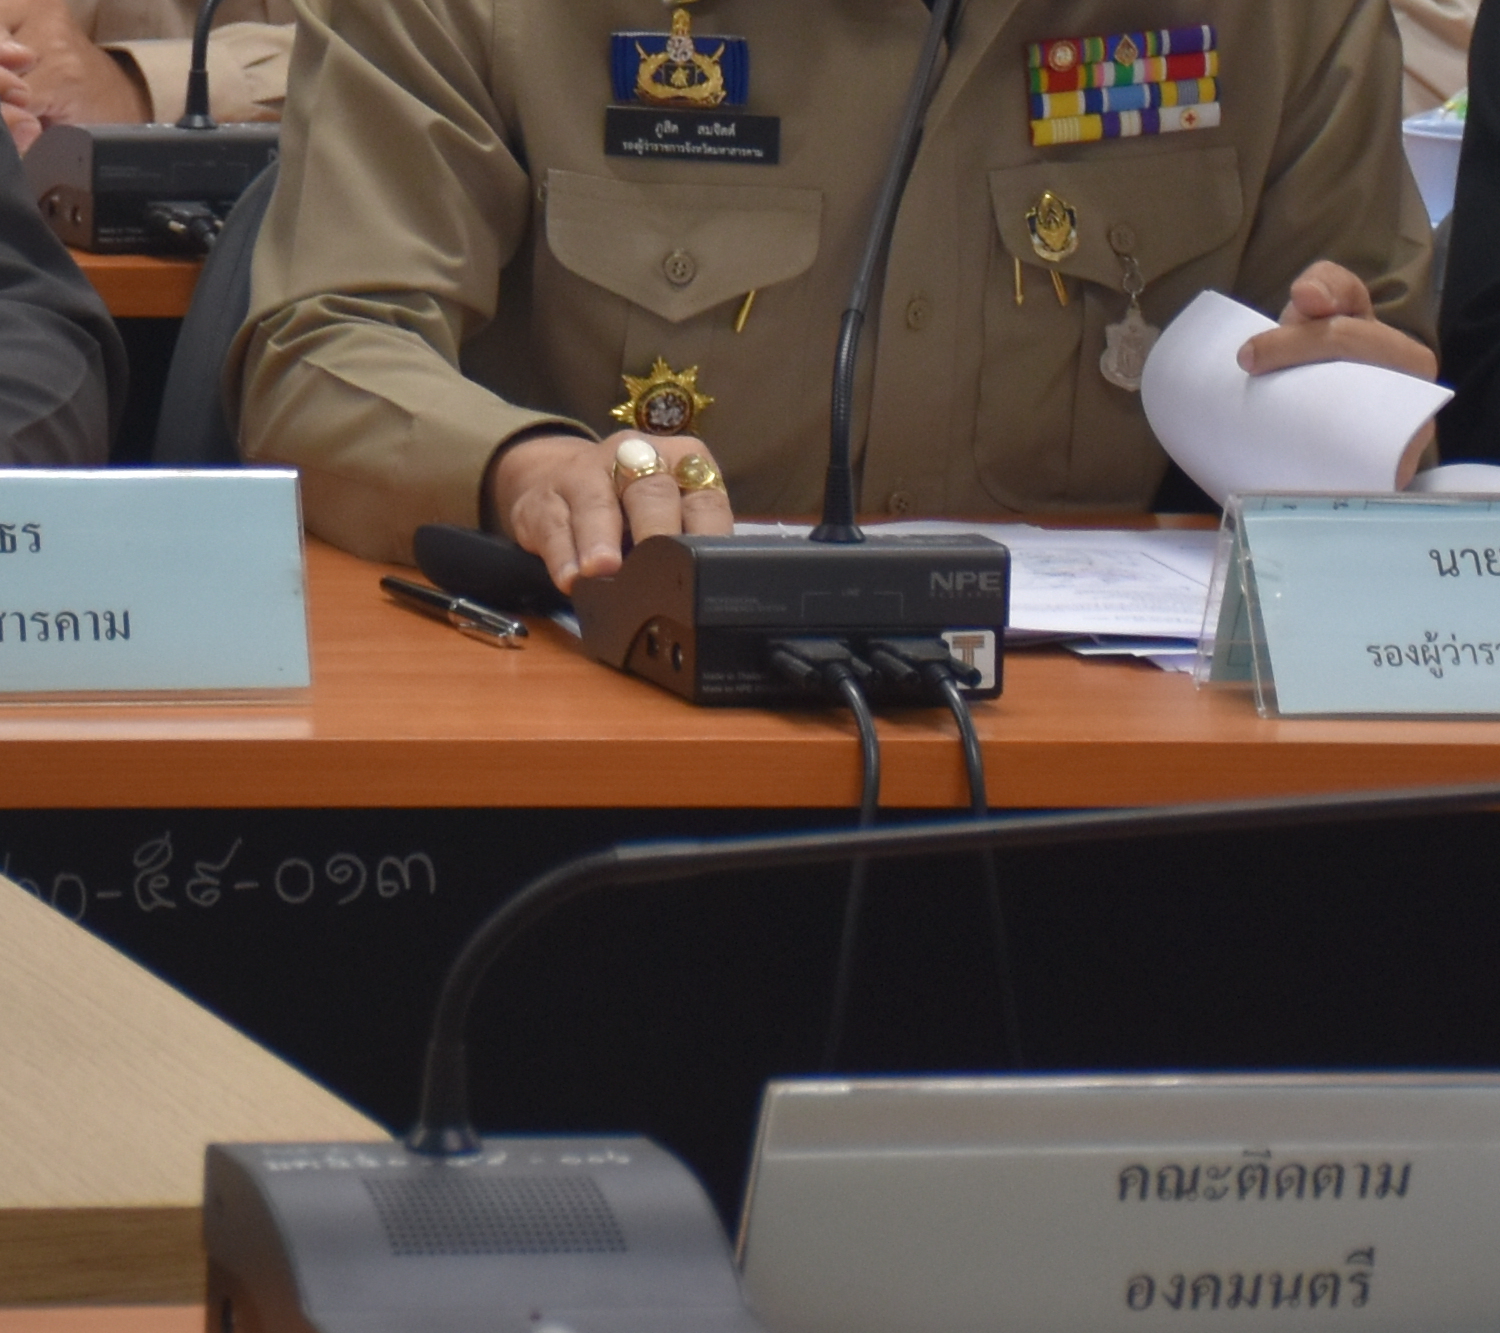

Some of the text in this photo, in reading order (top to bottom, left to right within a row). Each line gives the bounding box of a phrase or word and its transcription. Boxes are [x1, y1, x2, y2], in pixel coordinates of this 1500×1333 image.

[929, 571, 1001, 591] NPE
[1118, 1148, 1412, 1202] คณะติดตาม
[1125, 1246, 1376, 1312] องคมนตรี
